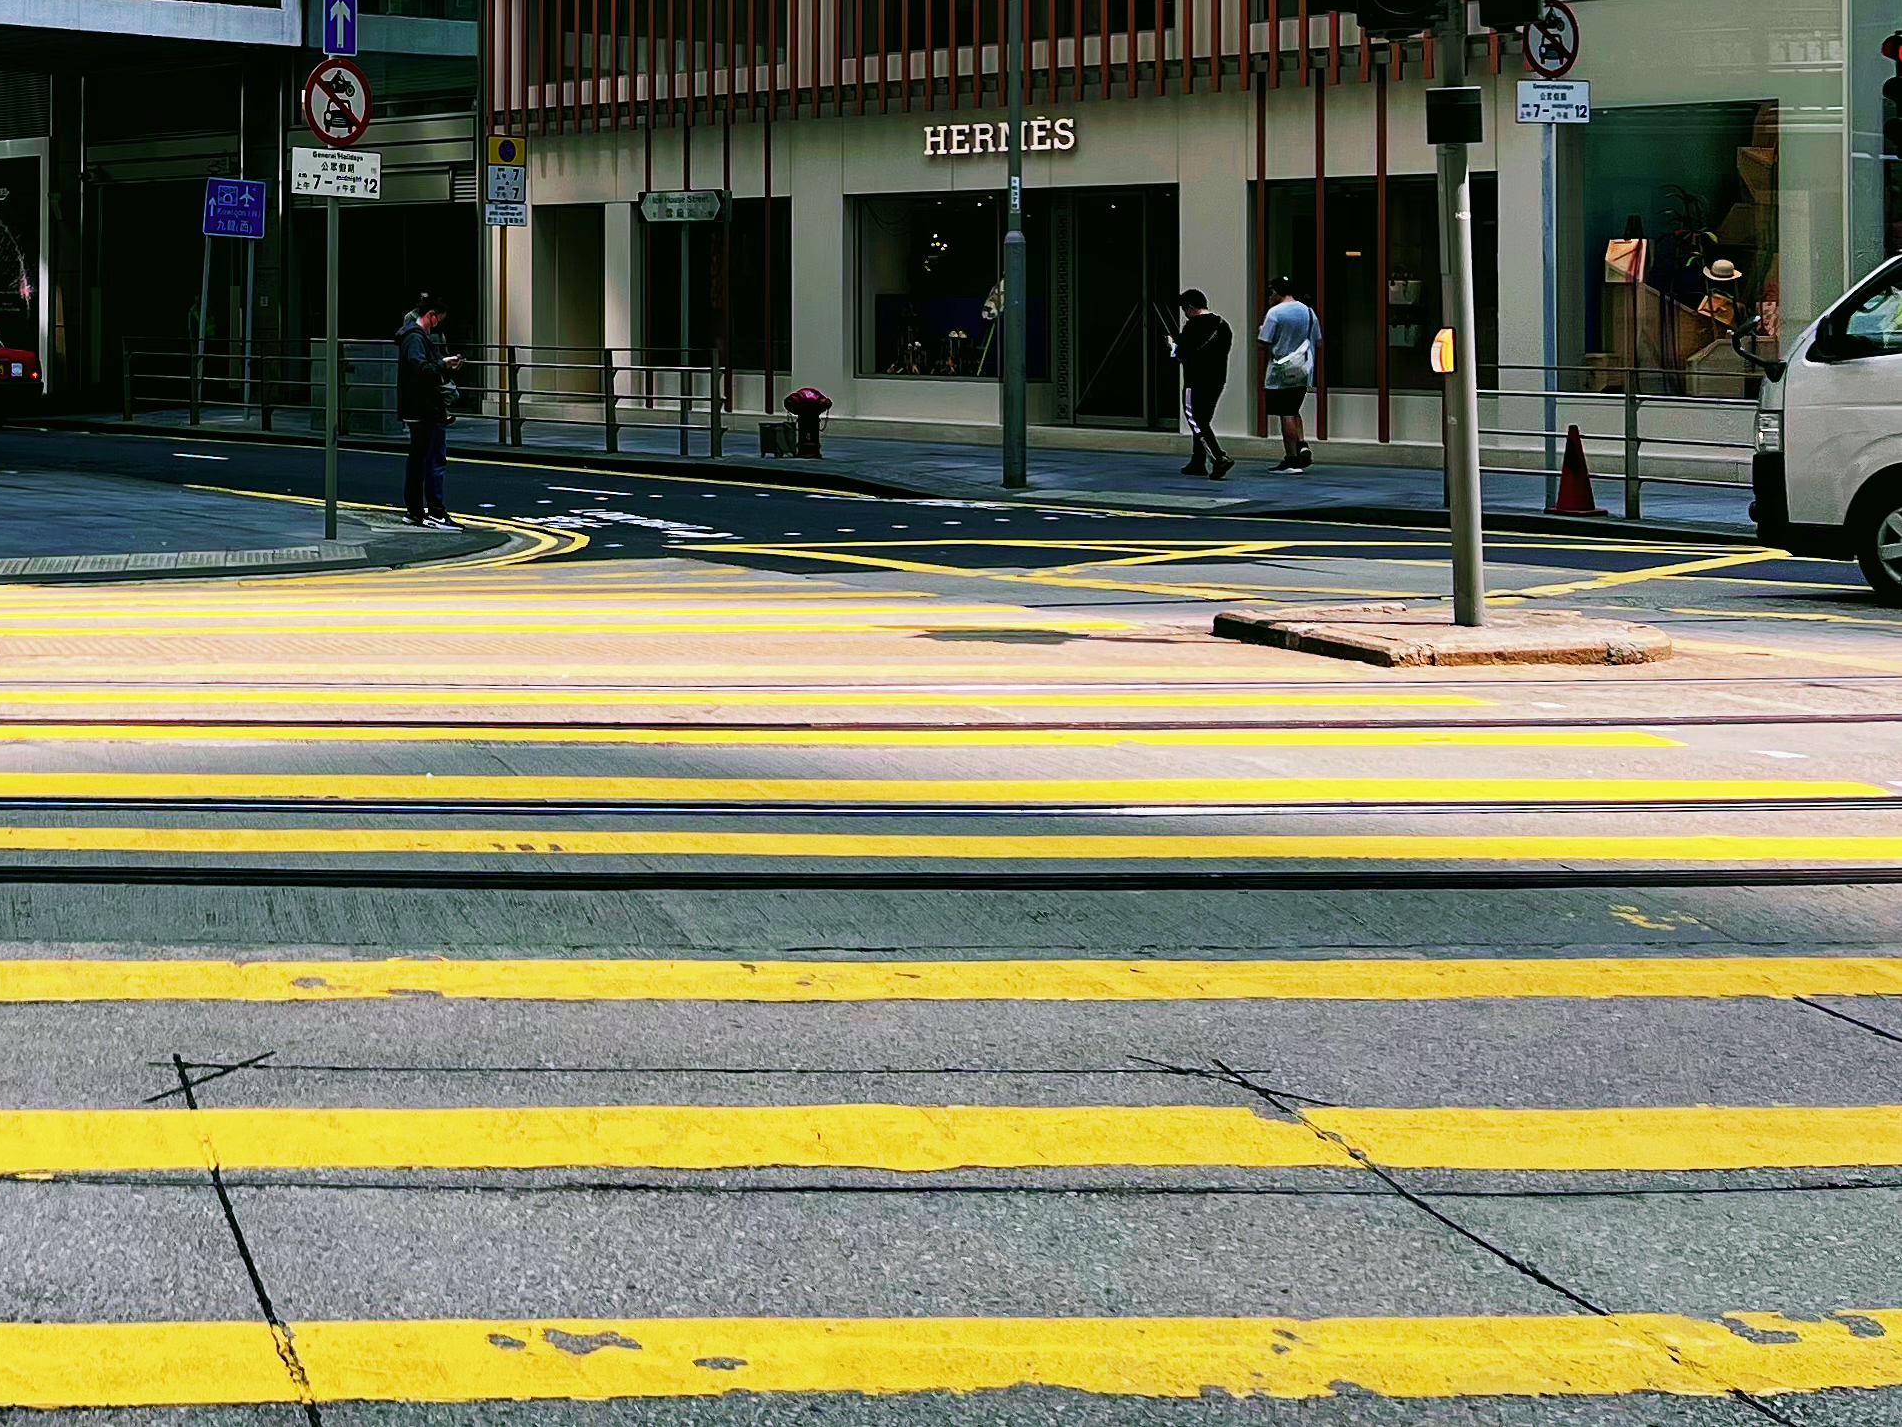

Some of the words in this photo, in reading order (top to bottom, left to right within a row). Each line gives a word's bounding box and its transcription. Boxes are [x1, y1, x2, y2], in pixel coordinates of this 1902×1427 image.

[1575, 104, 1587, 118] 12
[312, 151, 336, 160] General
[364, 178, 378, 194] 12
[686, 195, 709, 203] Street
